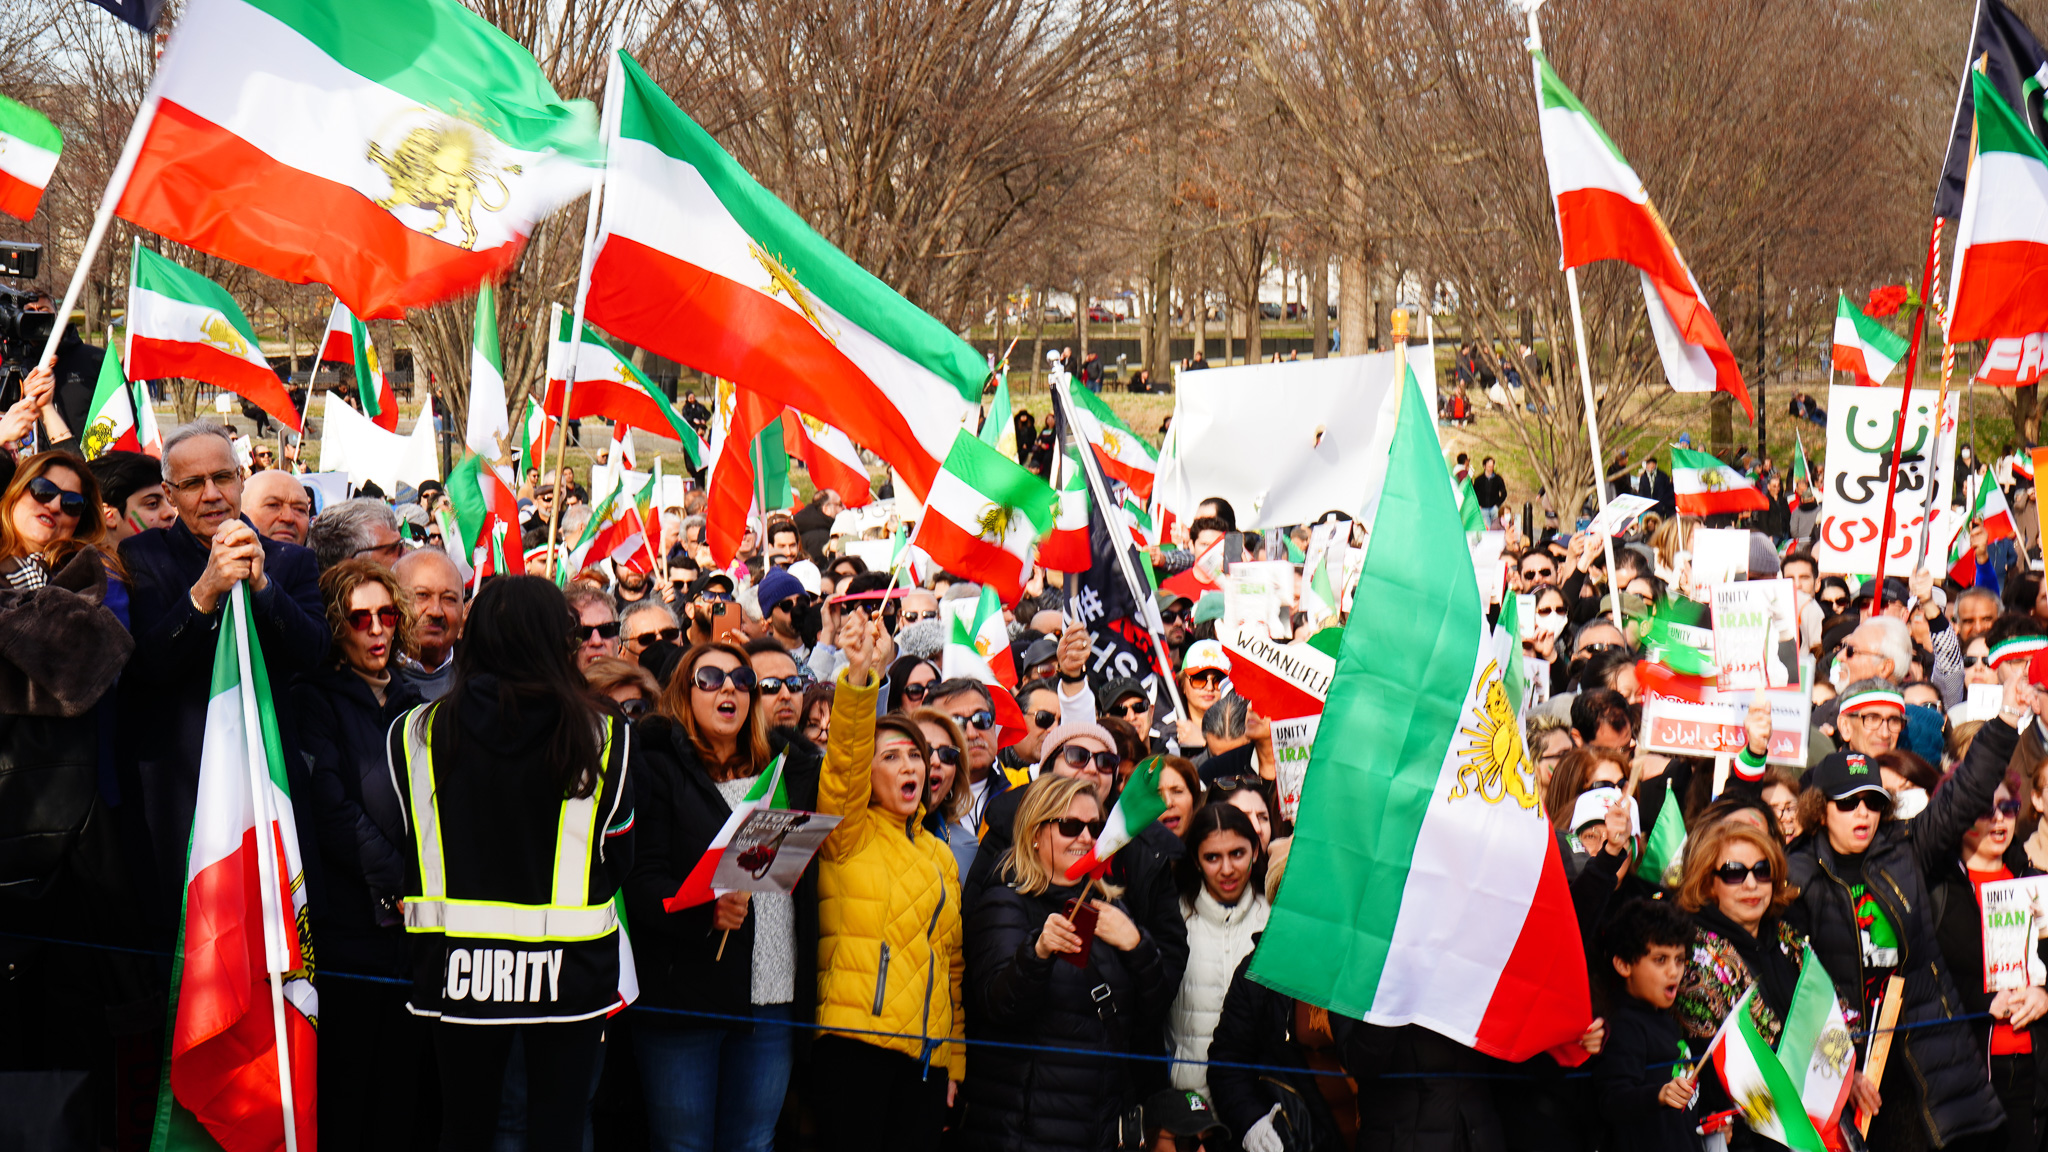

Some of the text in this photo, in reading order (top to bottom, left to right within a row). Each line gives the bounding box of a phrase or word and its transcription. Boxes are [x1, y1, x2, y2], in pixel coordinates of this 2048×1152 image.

[1846, 405, 1929, 456] زن
[1717, 589, 1749, 604] UNITY
[1719, 611, 1763, 628] IRAN
[1670, 626, 1691, 642] UNITY
[1276, 724, 1308, 740] UNITY
[1661, 722, 1700, 746] ایران
[1986, 888, 2015, 903] UNITY
[1988, 910, 2026, 929] IRAN
[442, 948, 563, 1002] CURITY
